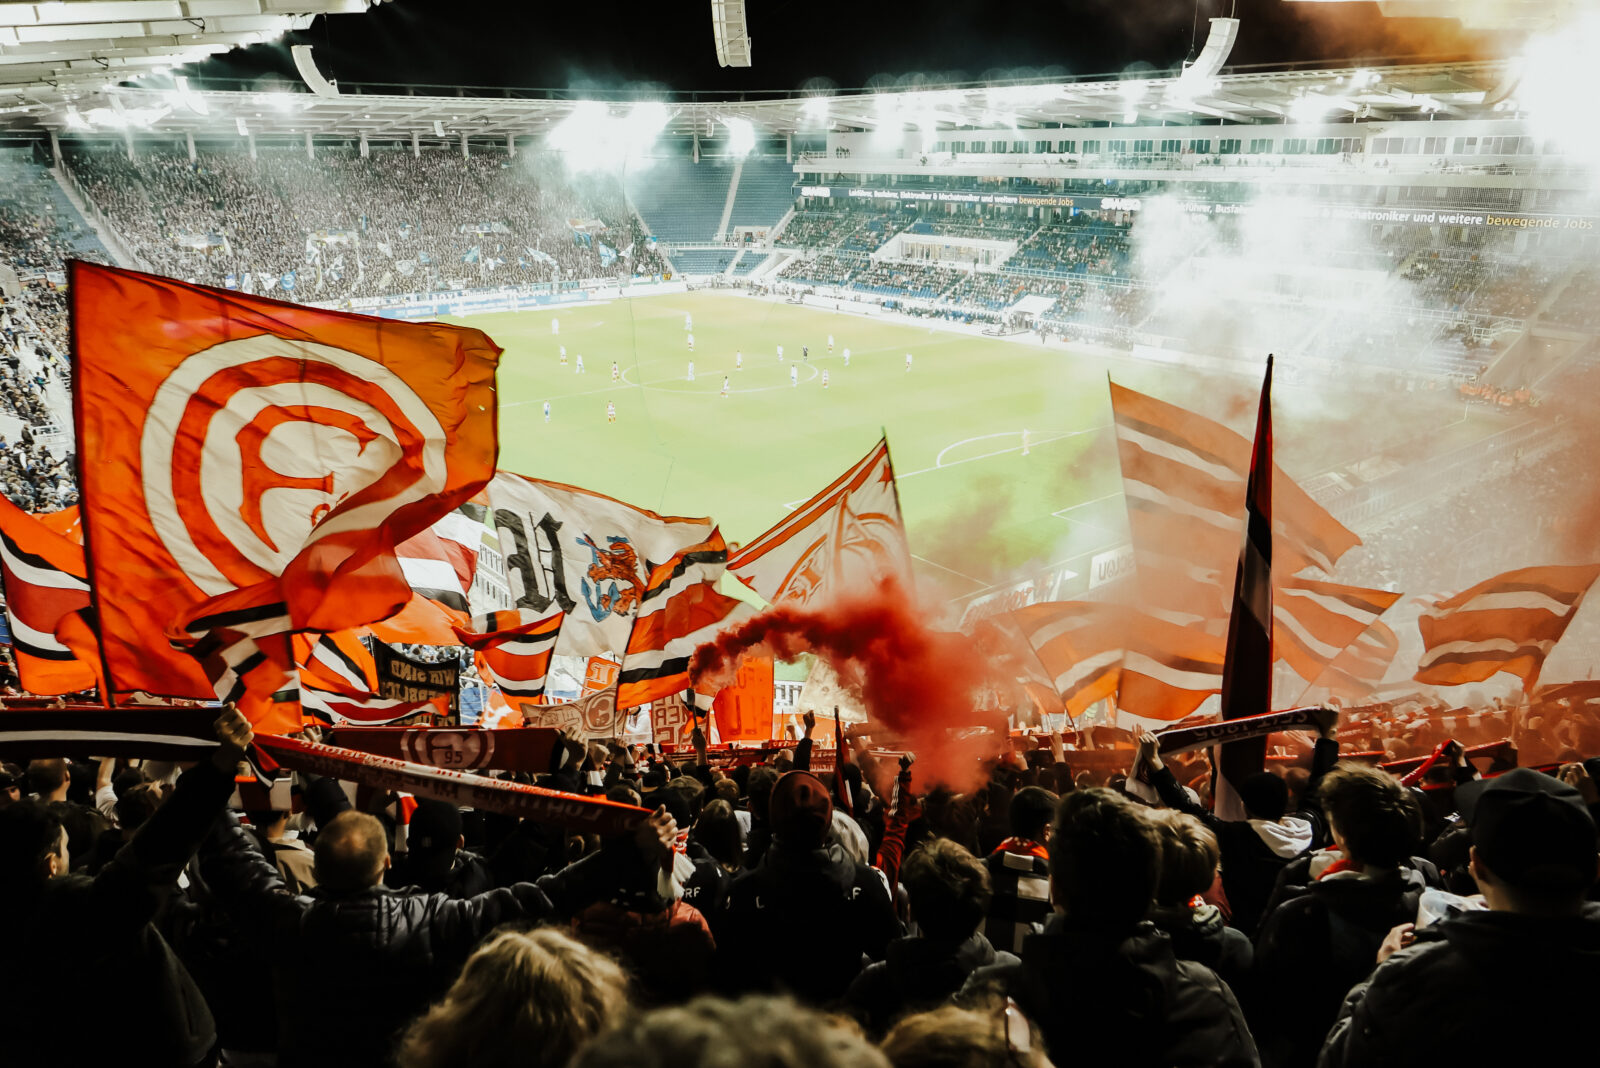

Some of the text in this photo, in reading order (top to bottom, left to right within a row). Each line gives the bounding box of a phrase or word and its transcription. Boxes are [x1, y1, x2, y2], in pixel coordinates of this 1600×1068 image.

[981, 194, 993, 203] und
[994, 196, 1018, 205] weitere
[1019, 195, 1057, 207] bewegende
[1058, 197, 1075, 207] Jobs
[1413, 212, 1436, 223] und
[1439, 213, 1483, 225] weitere
[1486, 214, 1560, 229] bewegende
[1563, 217, 1594, 230] Jobs
[444, 751, 463, 764] 95
